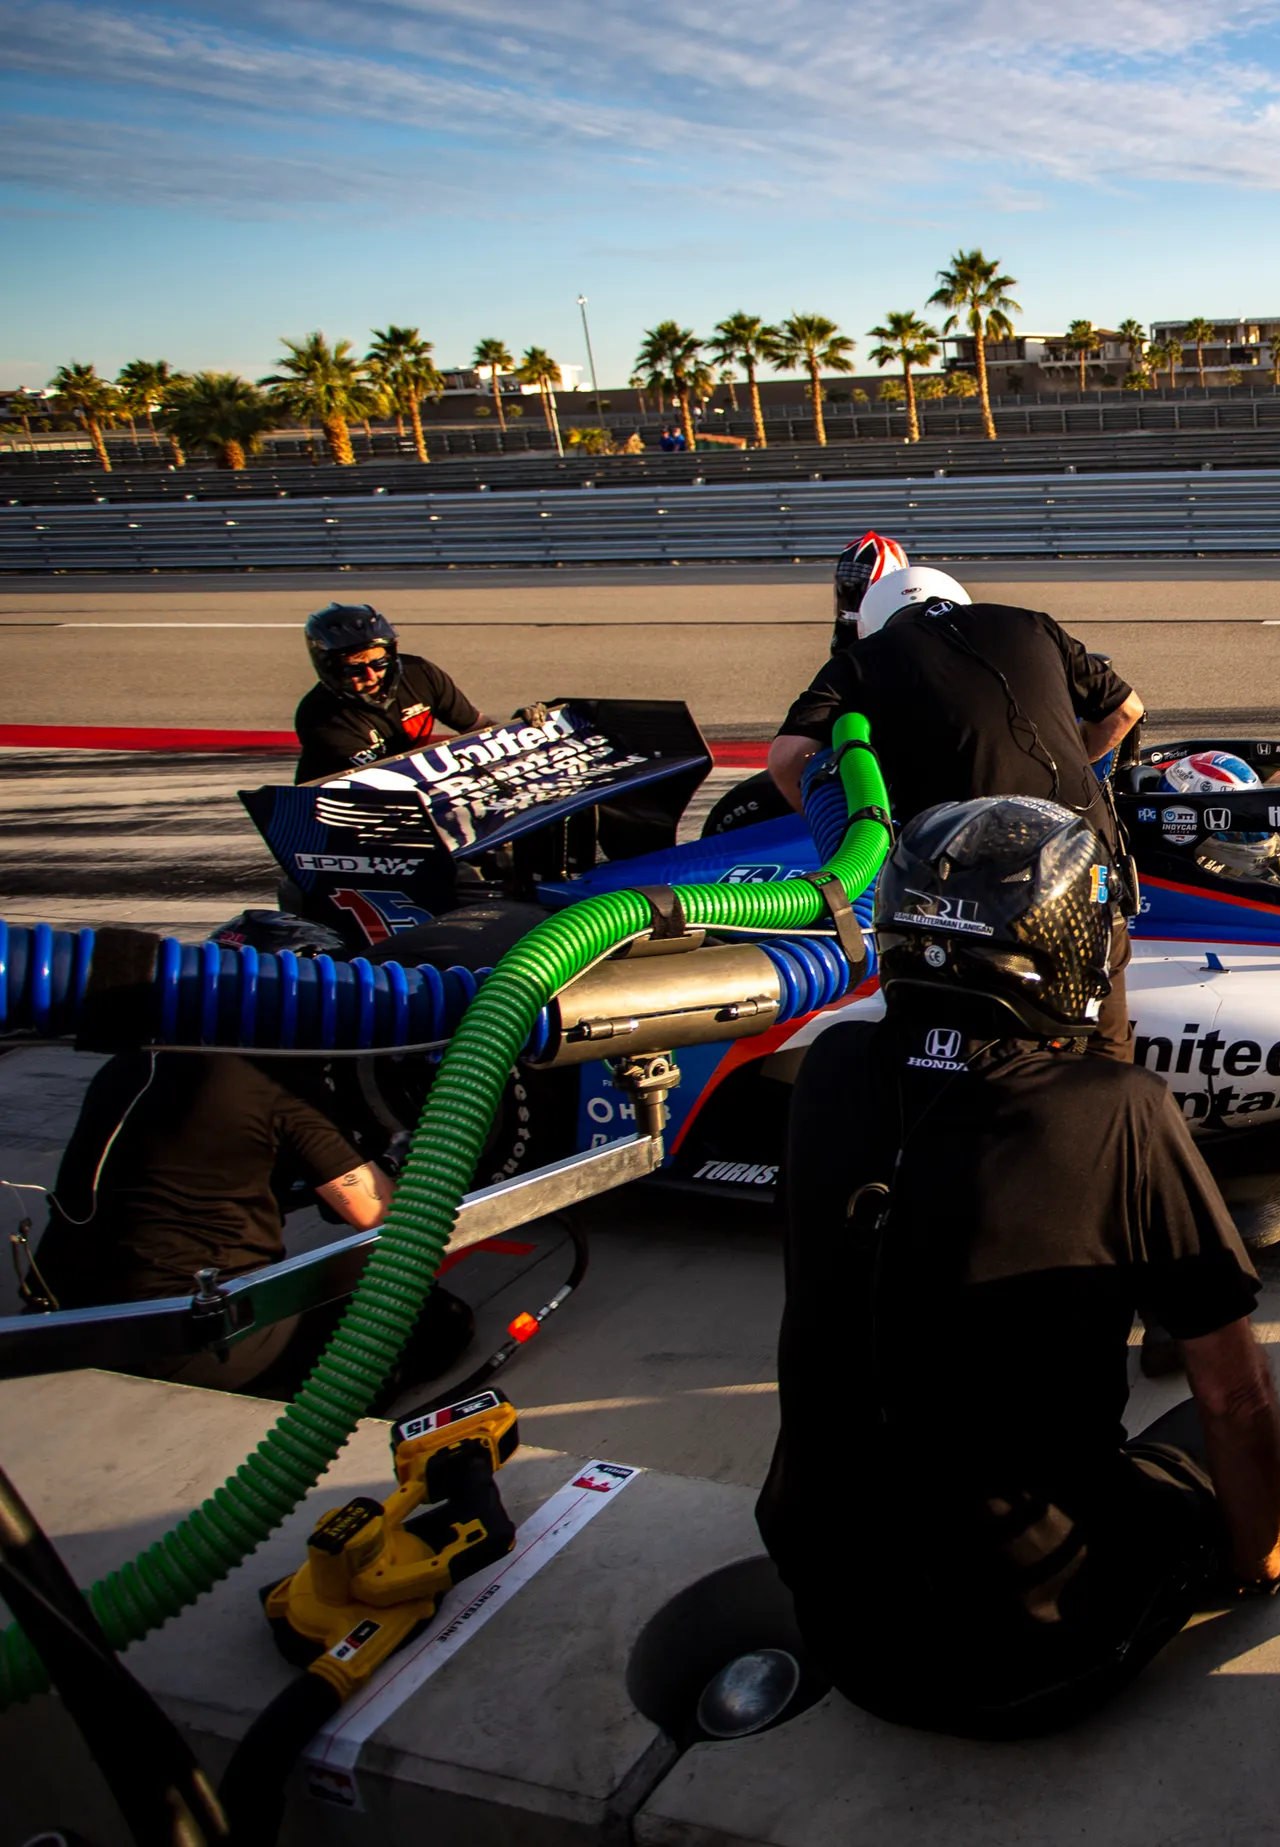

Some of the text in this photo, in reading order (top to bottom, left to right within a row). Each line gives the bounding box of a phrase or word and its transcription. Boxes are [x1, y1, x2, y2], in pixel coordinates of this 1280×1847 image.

[410, 709, 575, 783] United
[1138, 808, 1157, 821] PPG
[1162, 823, 1198, 831] INDYCAR
[297, 856, 358, 871] HPD
[915, 914, 958, 930] LETTERMAN
[958, 922, 993, 935] LANIGAN
[907, 1056, 969, 1072] HONDA
[692, 1160, 780, 1184] TURNS
[436, 1584, 502, 1643] CENTER LINE
